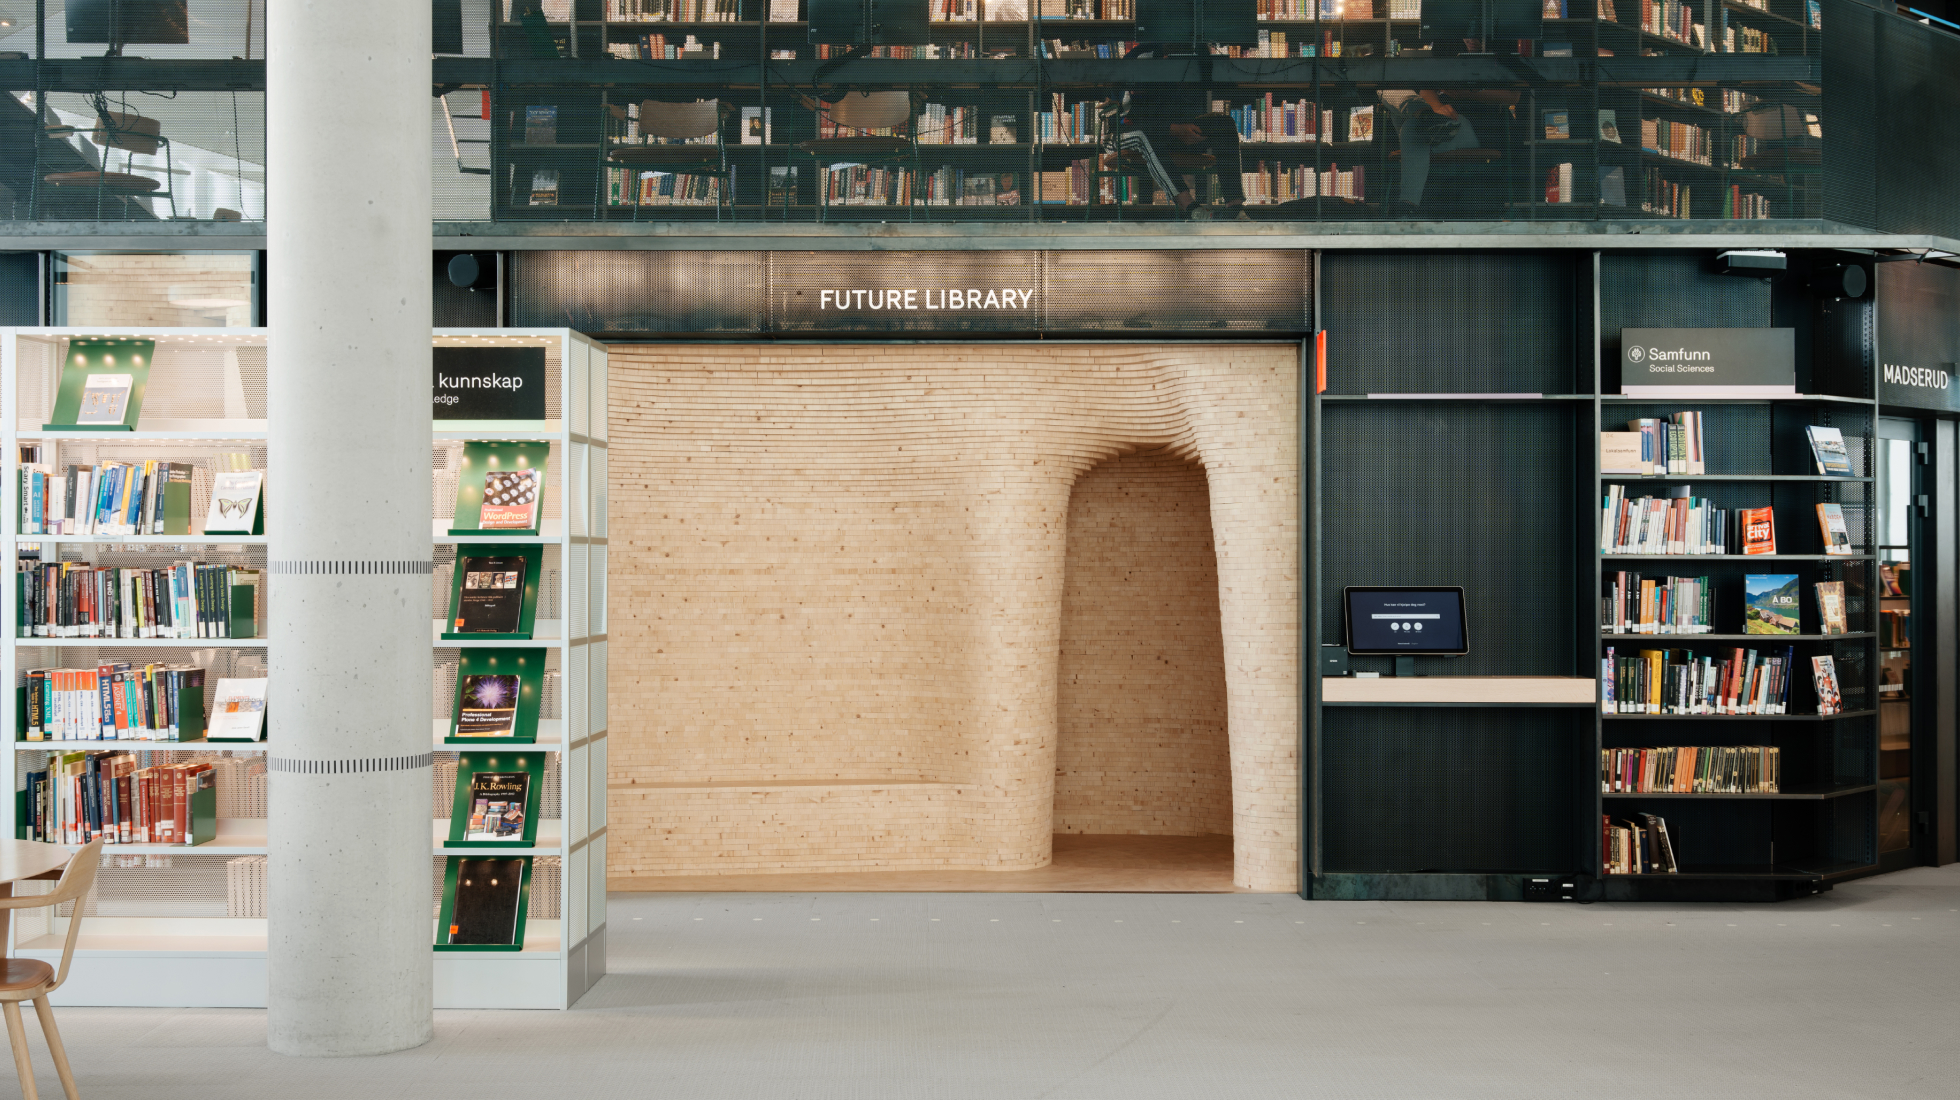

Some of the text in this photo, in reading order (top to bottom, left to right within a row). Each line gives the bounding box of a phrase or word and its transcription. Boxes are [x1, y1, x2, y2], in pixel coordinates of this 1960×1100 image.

[820, 289, 1034, 310] FUTURE LIBRARY
[1649, 347, 1711, 361] Samfunn
[1649, 364, 1715, 373] Social Sciences
[439, 372, 523, 392] kunnskap
[1883, 363, 1949, 390] MADSERUD
[432, 393, 460, 406] edge
[483, 511, 528, 520] WordPress
[1747, 522, 1770, 531] arrival
[1747, 527, 1770, 541] city
[1780, 596, 1793, 604] BO
[44, 681, 52, 706] Learning
[101, 679, 112, 710] HTML5
[31, 704, 39, 726] HTML5
[490, 782, 522, 793] Rowling
